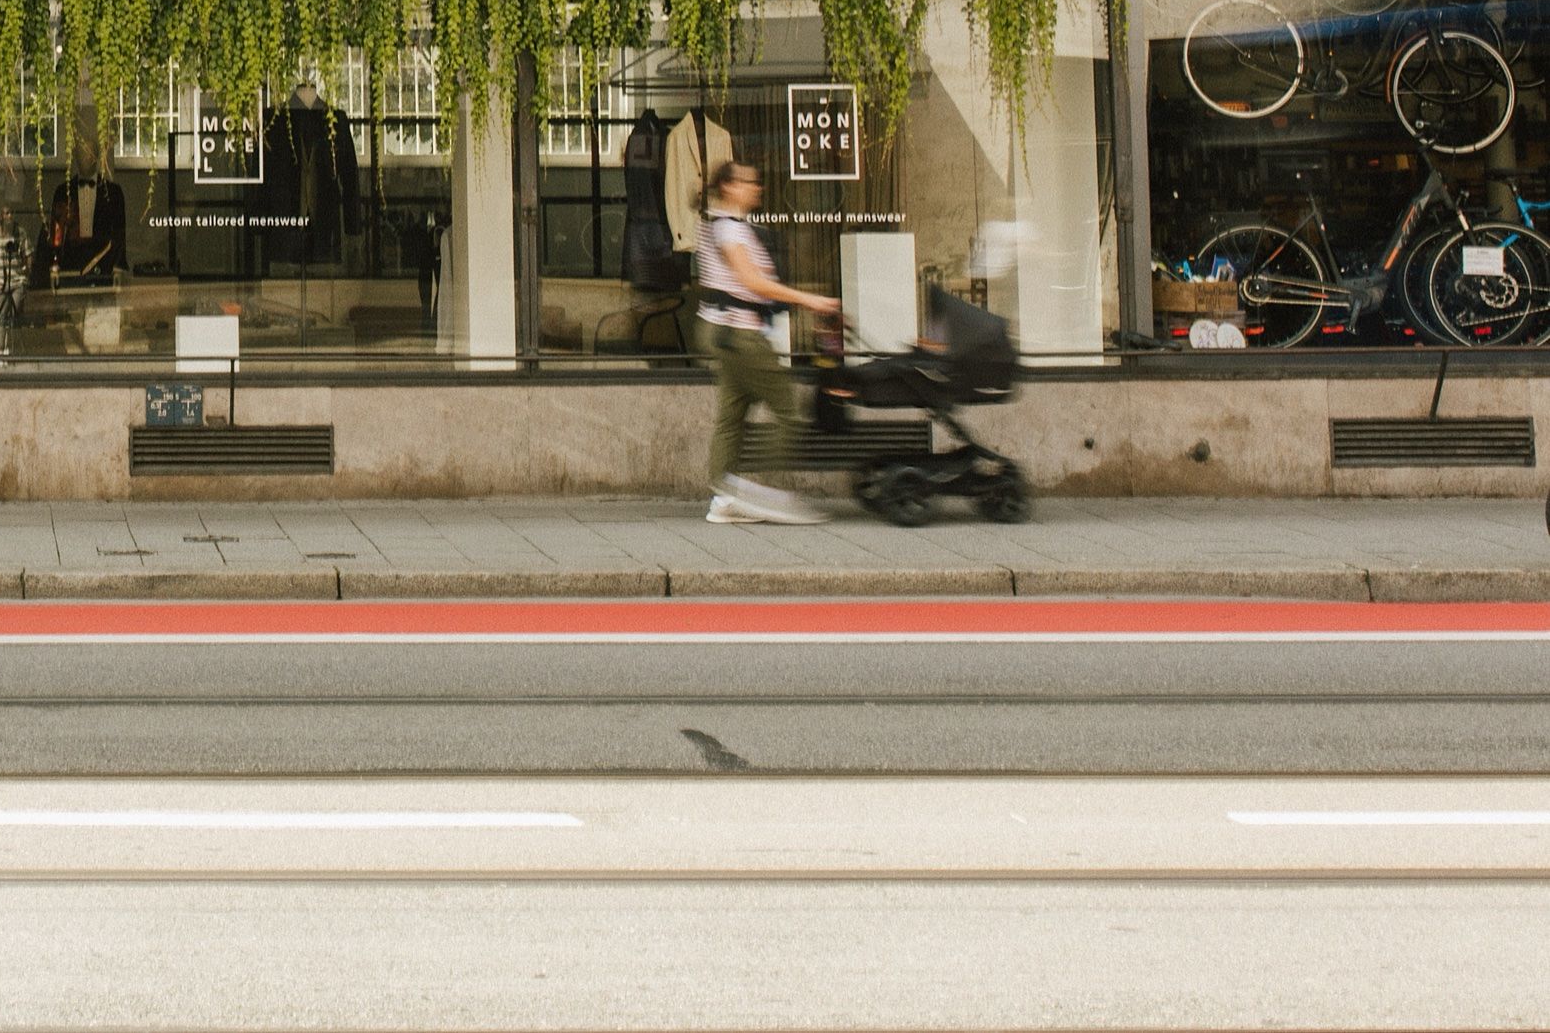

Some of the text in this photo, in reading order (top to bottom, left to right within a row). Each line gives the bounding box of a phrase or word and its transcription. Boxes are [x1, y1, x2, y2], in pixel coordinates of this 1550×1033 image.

[202, 116, 253, 133] MON
[797, 112, 849, 129] MON
[202, 137, 254, 153] OKE
[797, 133, 850, 150] OKE
[203, 156, 213, 173] L
[799, 152, 809, 169] L
[149, 215, 309, 227] custom tailored menswear
[746, 212, 906, 224] custom tailored menswear
